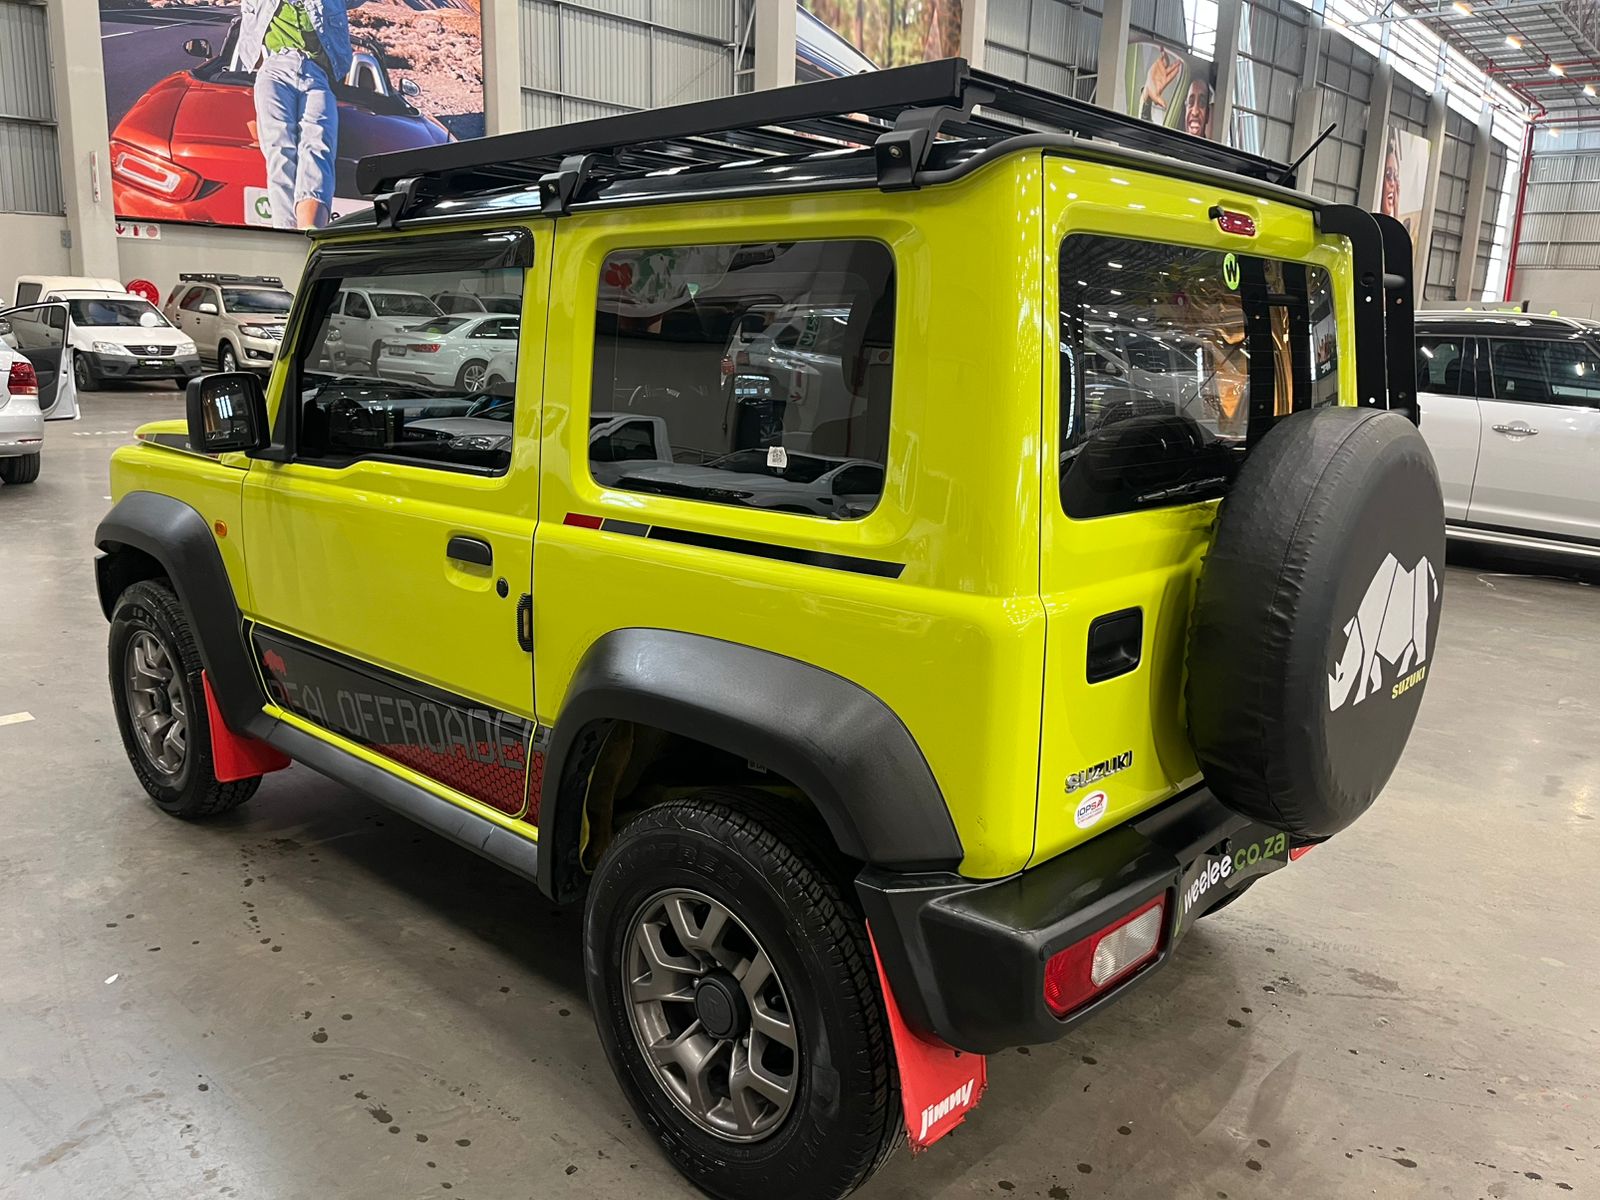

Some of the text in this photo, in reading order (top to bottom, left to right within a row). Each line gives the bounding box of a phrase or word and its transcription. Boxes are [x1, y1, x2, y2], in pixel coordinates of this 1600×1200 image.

[1391, 665, 1426, 700] SUZUKI
[1064, 750, 1134, 794] SUZUKI
[918, 1078, 975, 1142] Jimny
